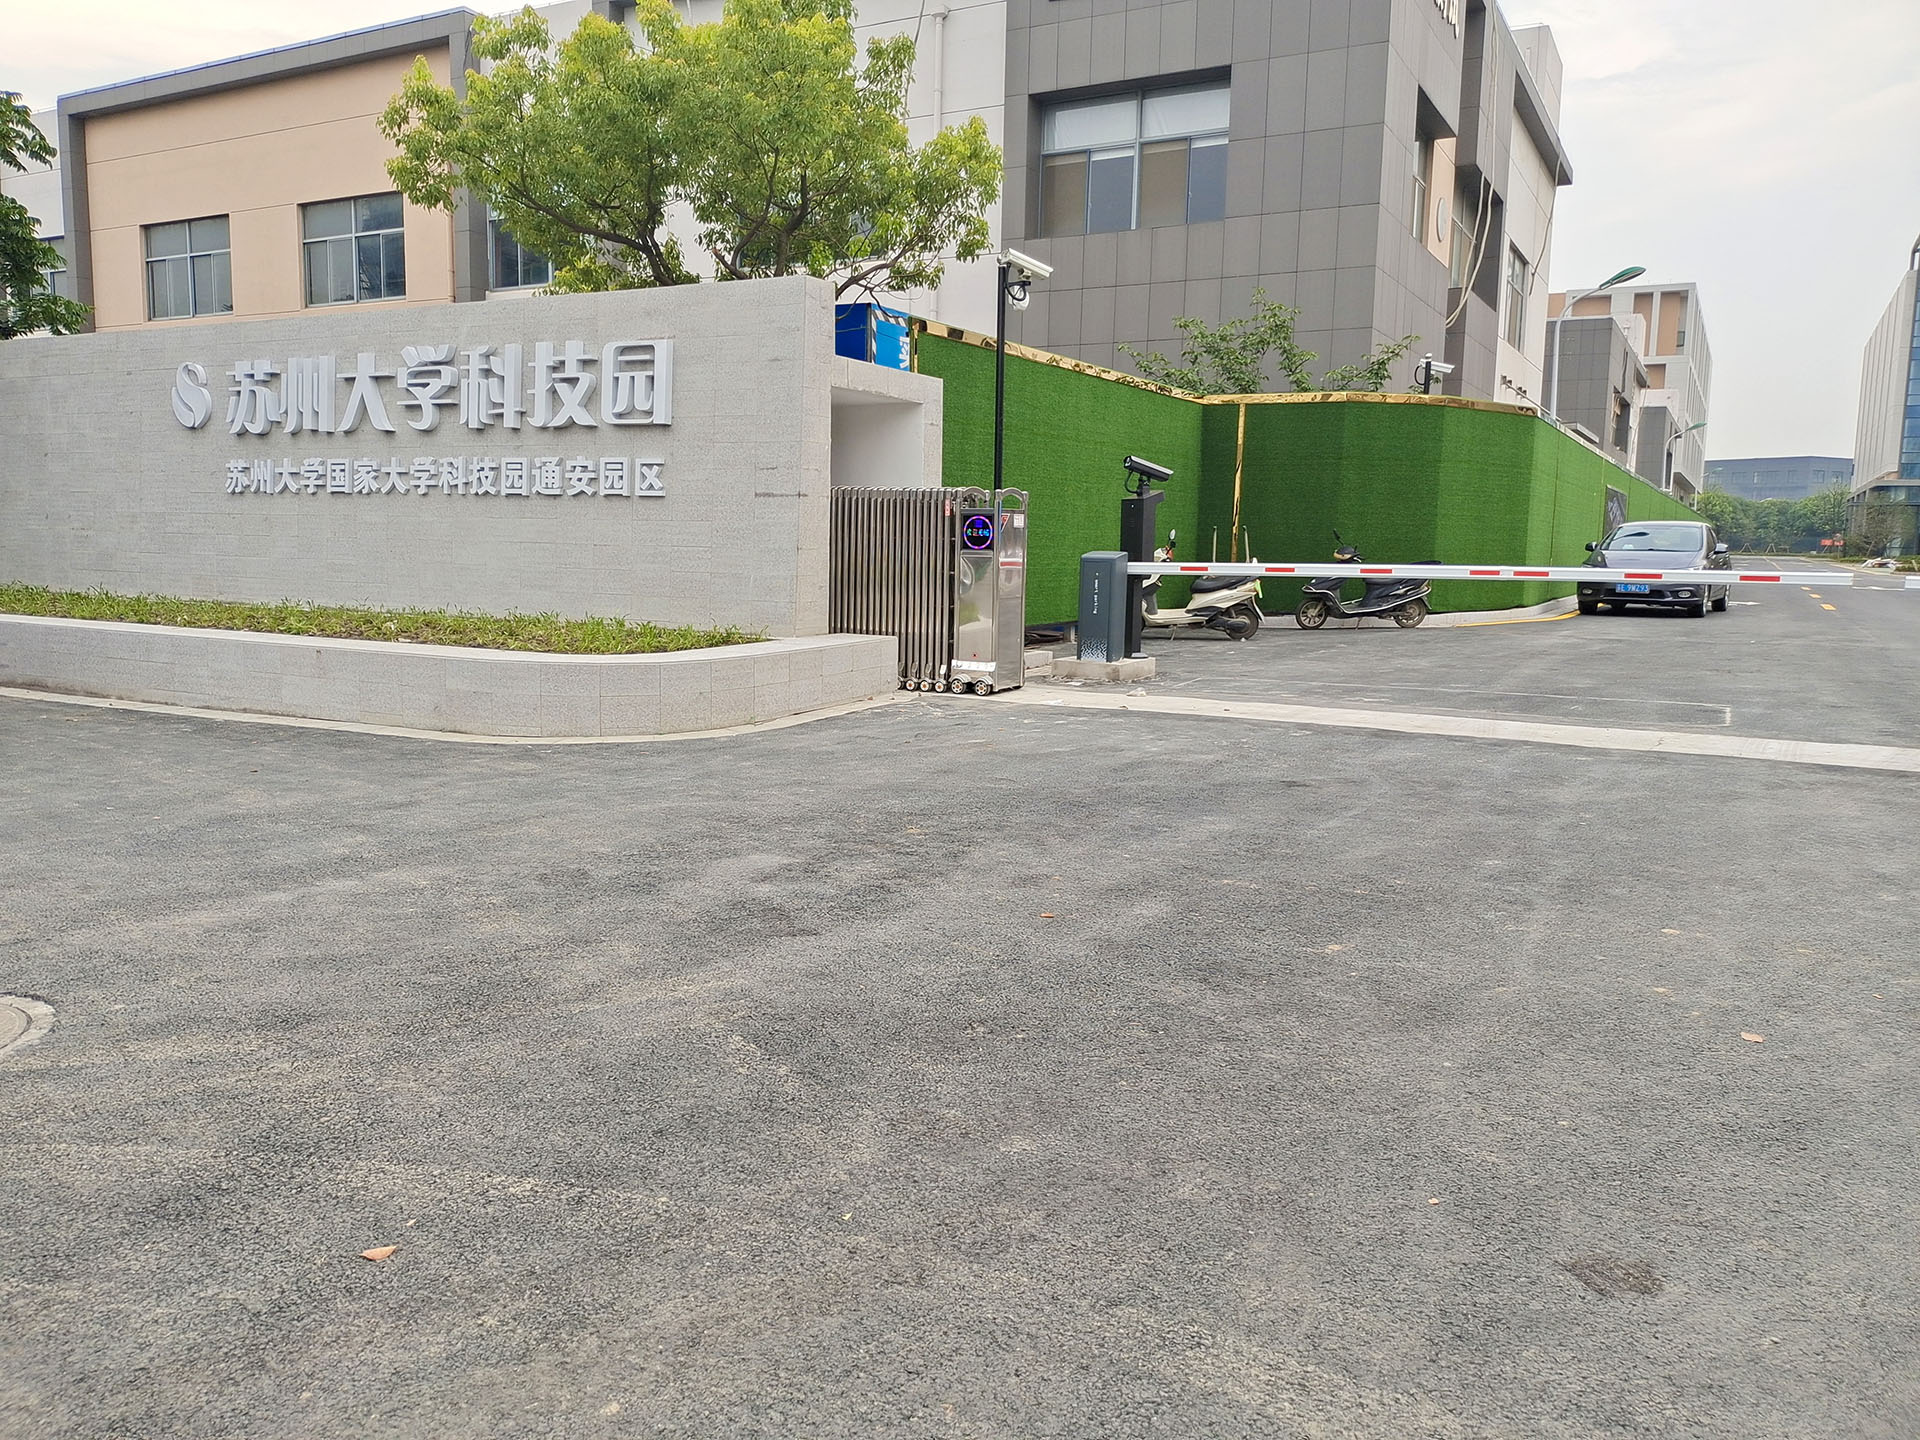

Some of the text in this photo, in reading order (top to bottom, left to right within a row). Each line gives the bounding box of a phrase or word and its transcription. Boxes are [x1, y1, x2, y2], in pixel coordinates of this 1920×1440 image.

[226, 340, 673, 434] 苏州大学科技园
[225, 456, 666, 496] 苏州大学国家大学科技园通安园区
